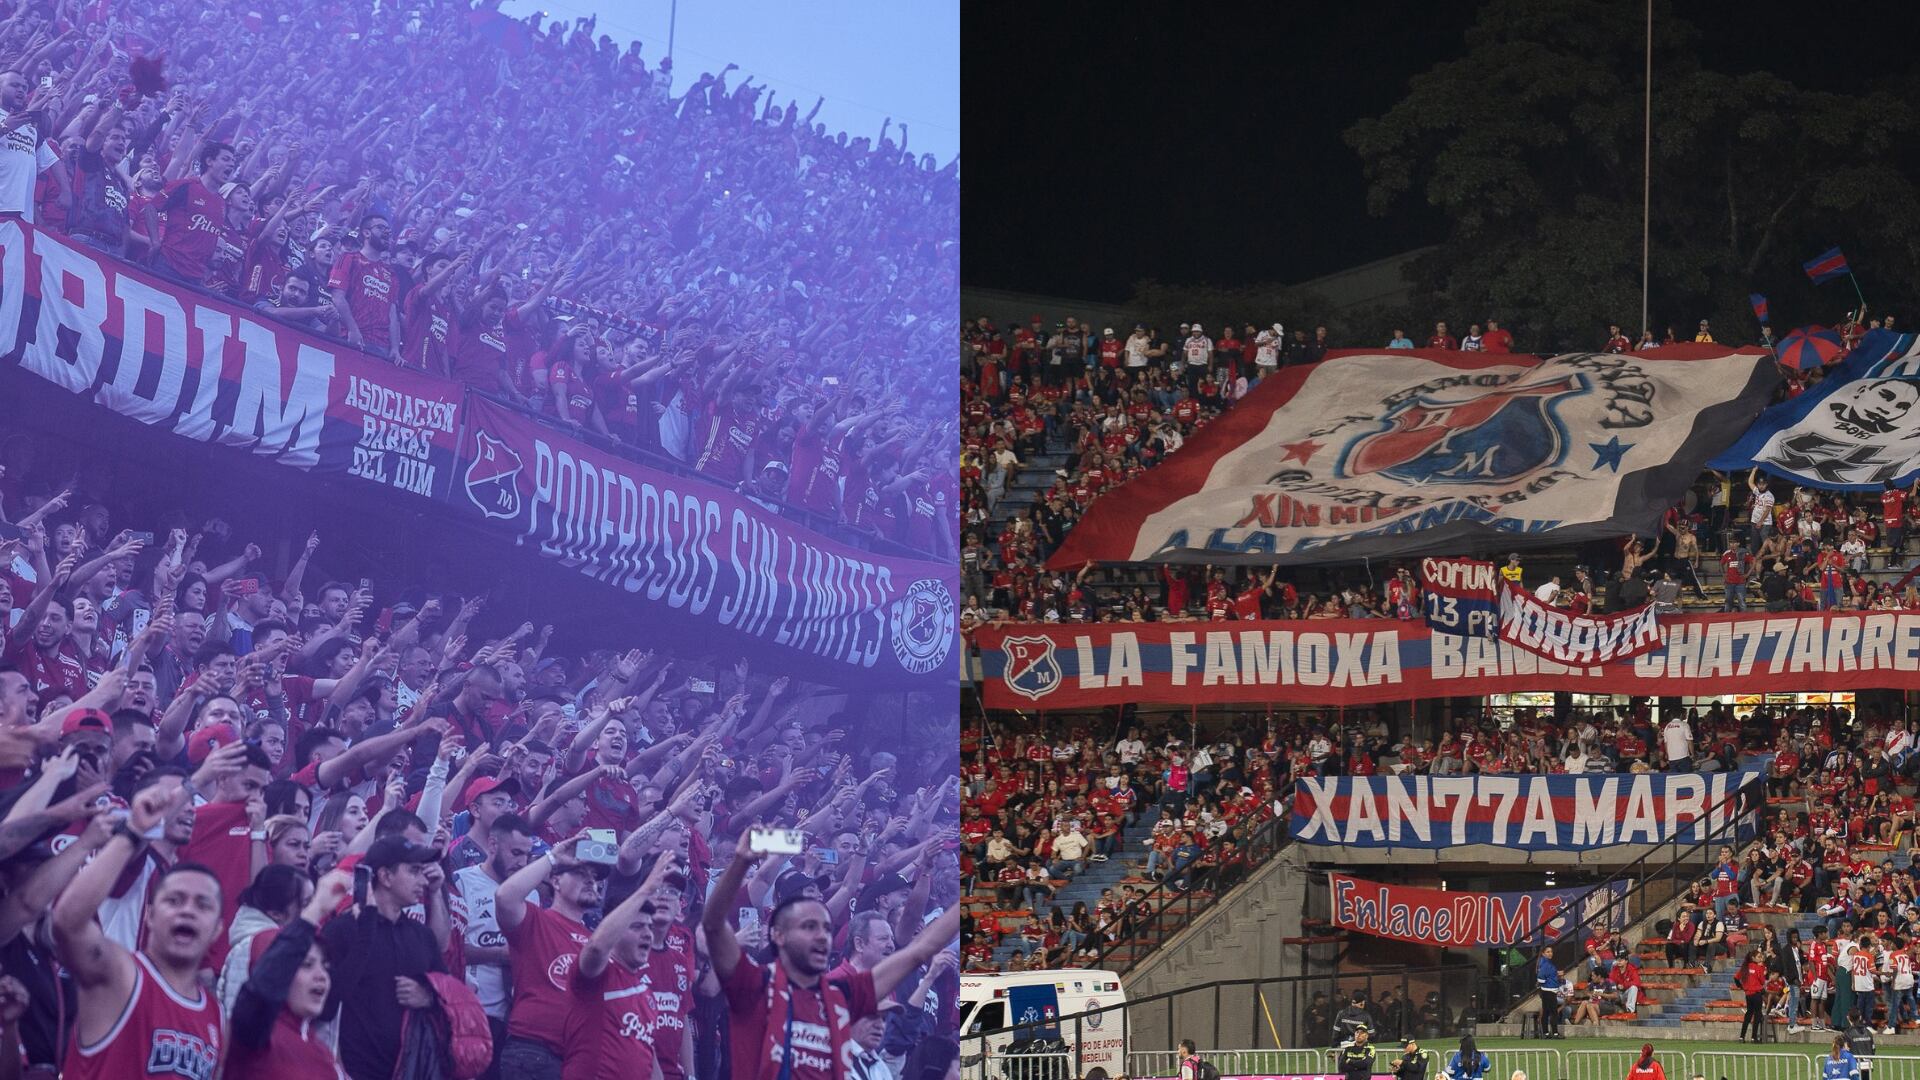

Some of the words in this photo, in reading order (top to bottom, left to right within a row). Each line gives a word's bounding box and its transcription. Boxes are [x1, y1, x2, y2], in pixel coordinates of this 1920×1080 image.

[345, 375, 456, 433] ASOCIACIÓN
[359, 414, 434, 460] BARRAS
[347, 446, 387, 483] DEL
[393, 456, 436, 497] DIM
[1233, 493, 1321, 529] XIN
[515, 439, 722, 615] PODEROSOS
[719, 508, 779, 637] SIN
[774, 536, 895, 669] LIMITES
[1204, 528, 1277, 554] LA
[1422, 557, 1497, 596] COMUN
[1428, 592, 1460, 628] 13
[1501, 581, 1659, 664] MORAVIA
[893, 636, 908, 661] SIN
[906, 647, 946, 673] LIMITES
[1016, 646, 1028, 659] D
[1037, 672, 1050, 684] M
[1075, 631, 1143, 689] LA
[1170, 630, 1403, 688] FAMOXA
[1296, 776, 1558, 845] XAN77A
[1336, 880, 1533, 945] EnlaceDIM
[1854, 956, 1866, 976] 29
[1093, 1039, 1101, 1050] DE
[1103, 1037, 1123, 1048] APOYO
